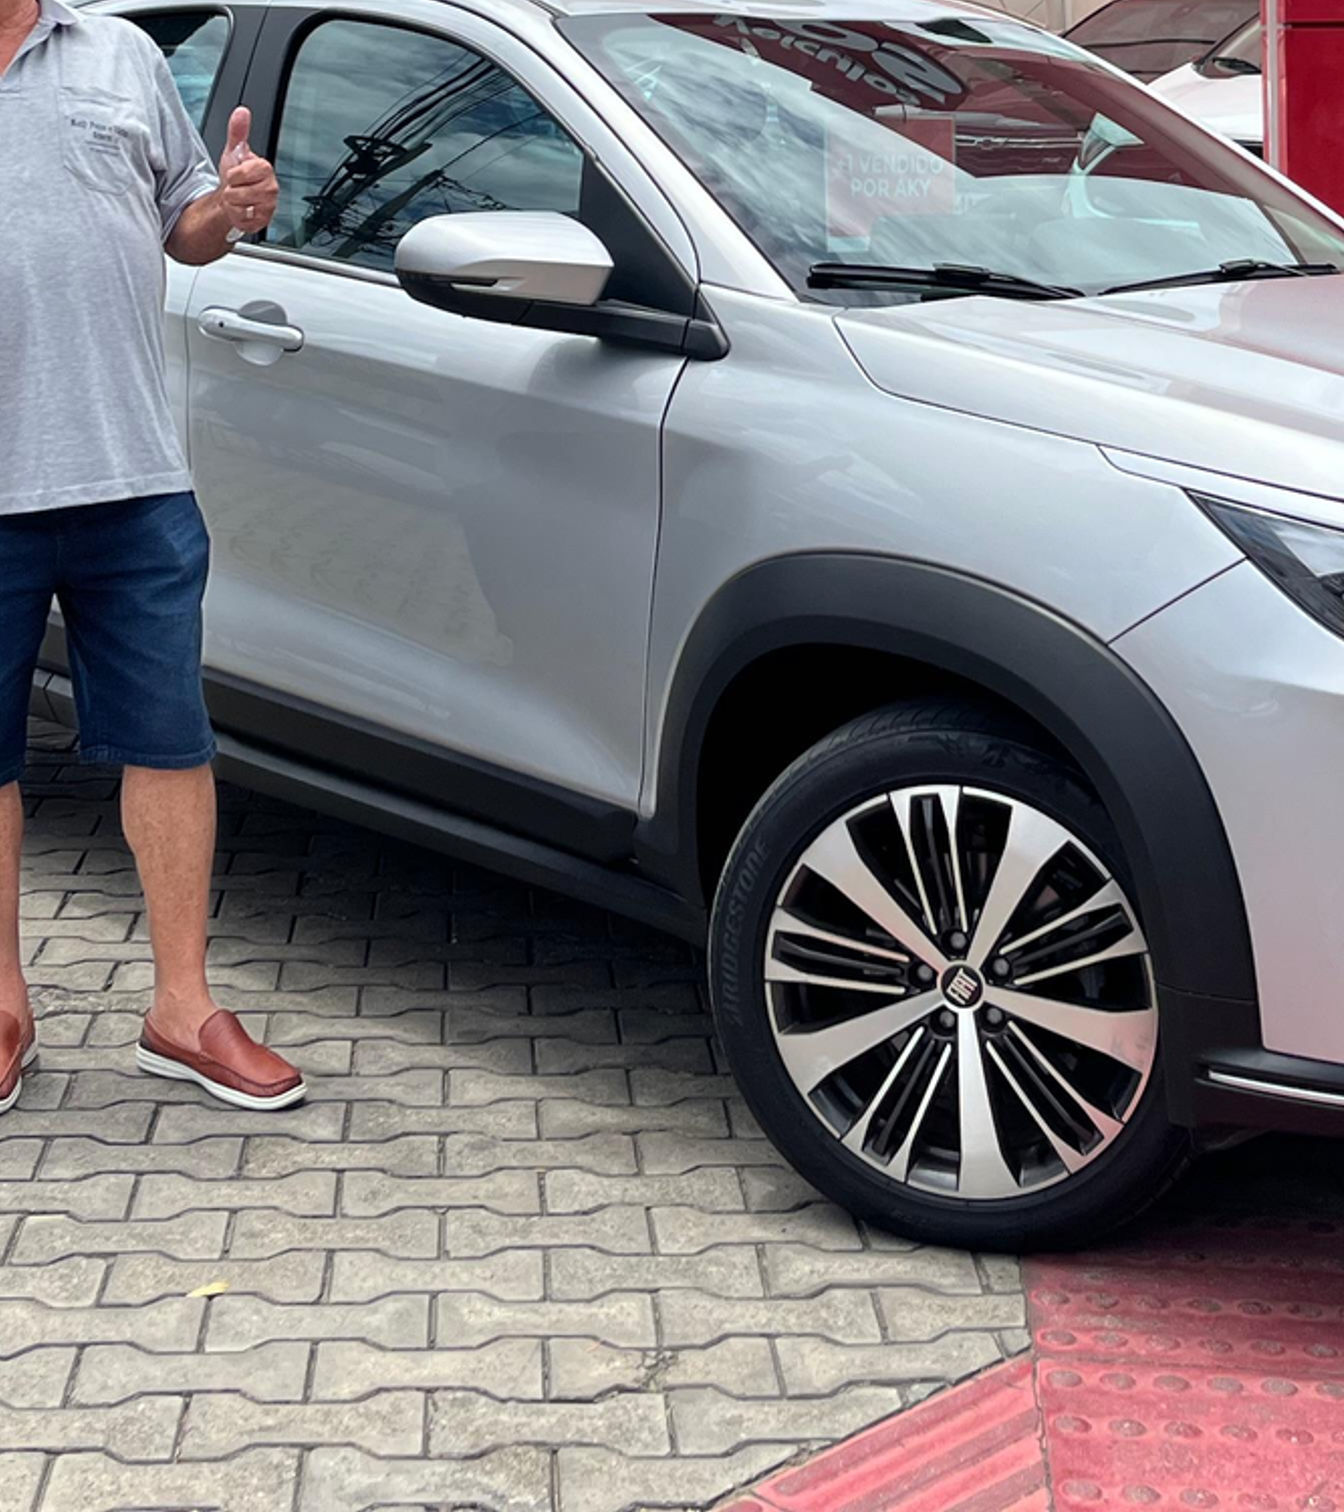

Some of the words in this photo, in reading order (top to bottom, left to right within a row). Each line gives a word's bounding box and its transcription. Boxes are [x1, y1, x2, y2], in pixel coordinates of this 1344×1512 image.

[859, 153, 944, 174] VENDIDO
[850, 178, 888, 197] POR
[720, 835, 769, 1027] BRIDGESTONE
